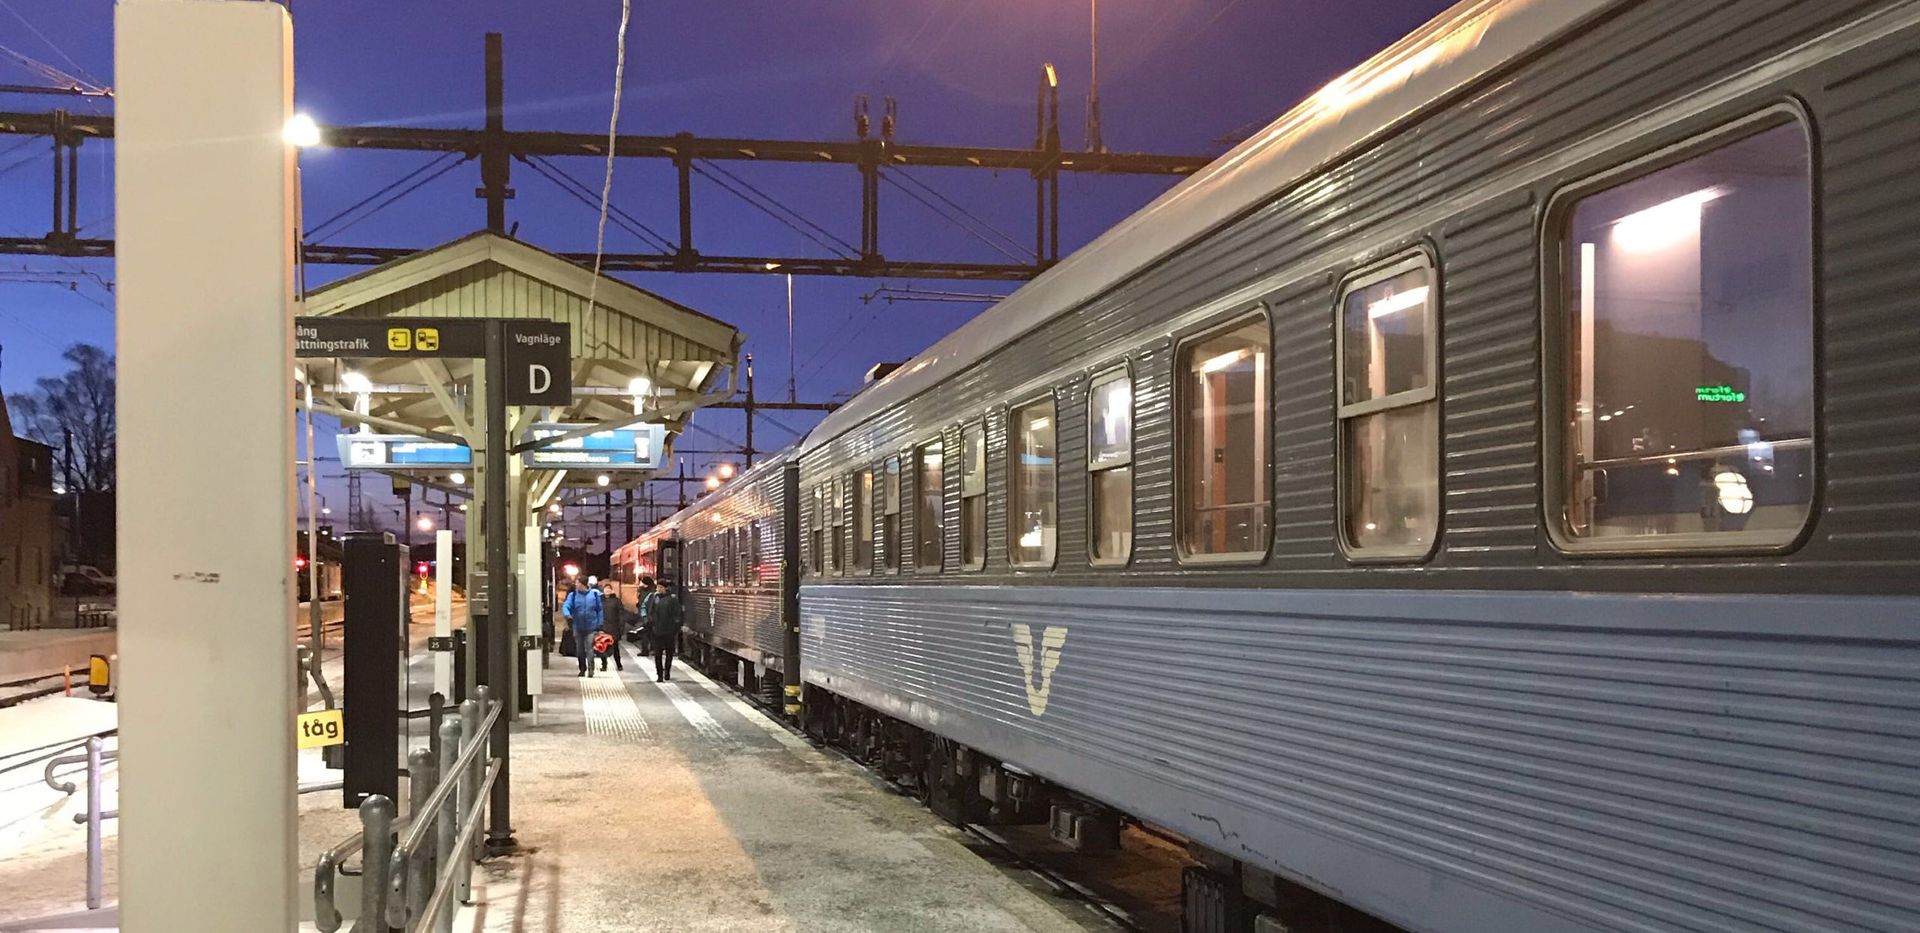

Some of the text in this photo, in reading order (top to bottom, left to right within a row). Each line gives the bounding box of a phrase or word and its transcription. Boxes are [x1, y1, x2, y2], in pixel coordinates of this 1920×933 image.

[515, 333, 561, 346] Vagnläge
[529, 364, 552, 394] D
[303, 718, 339, 739] tåg
